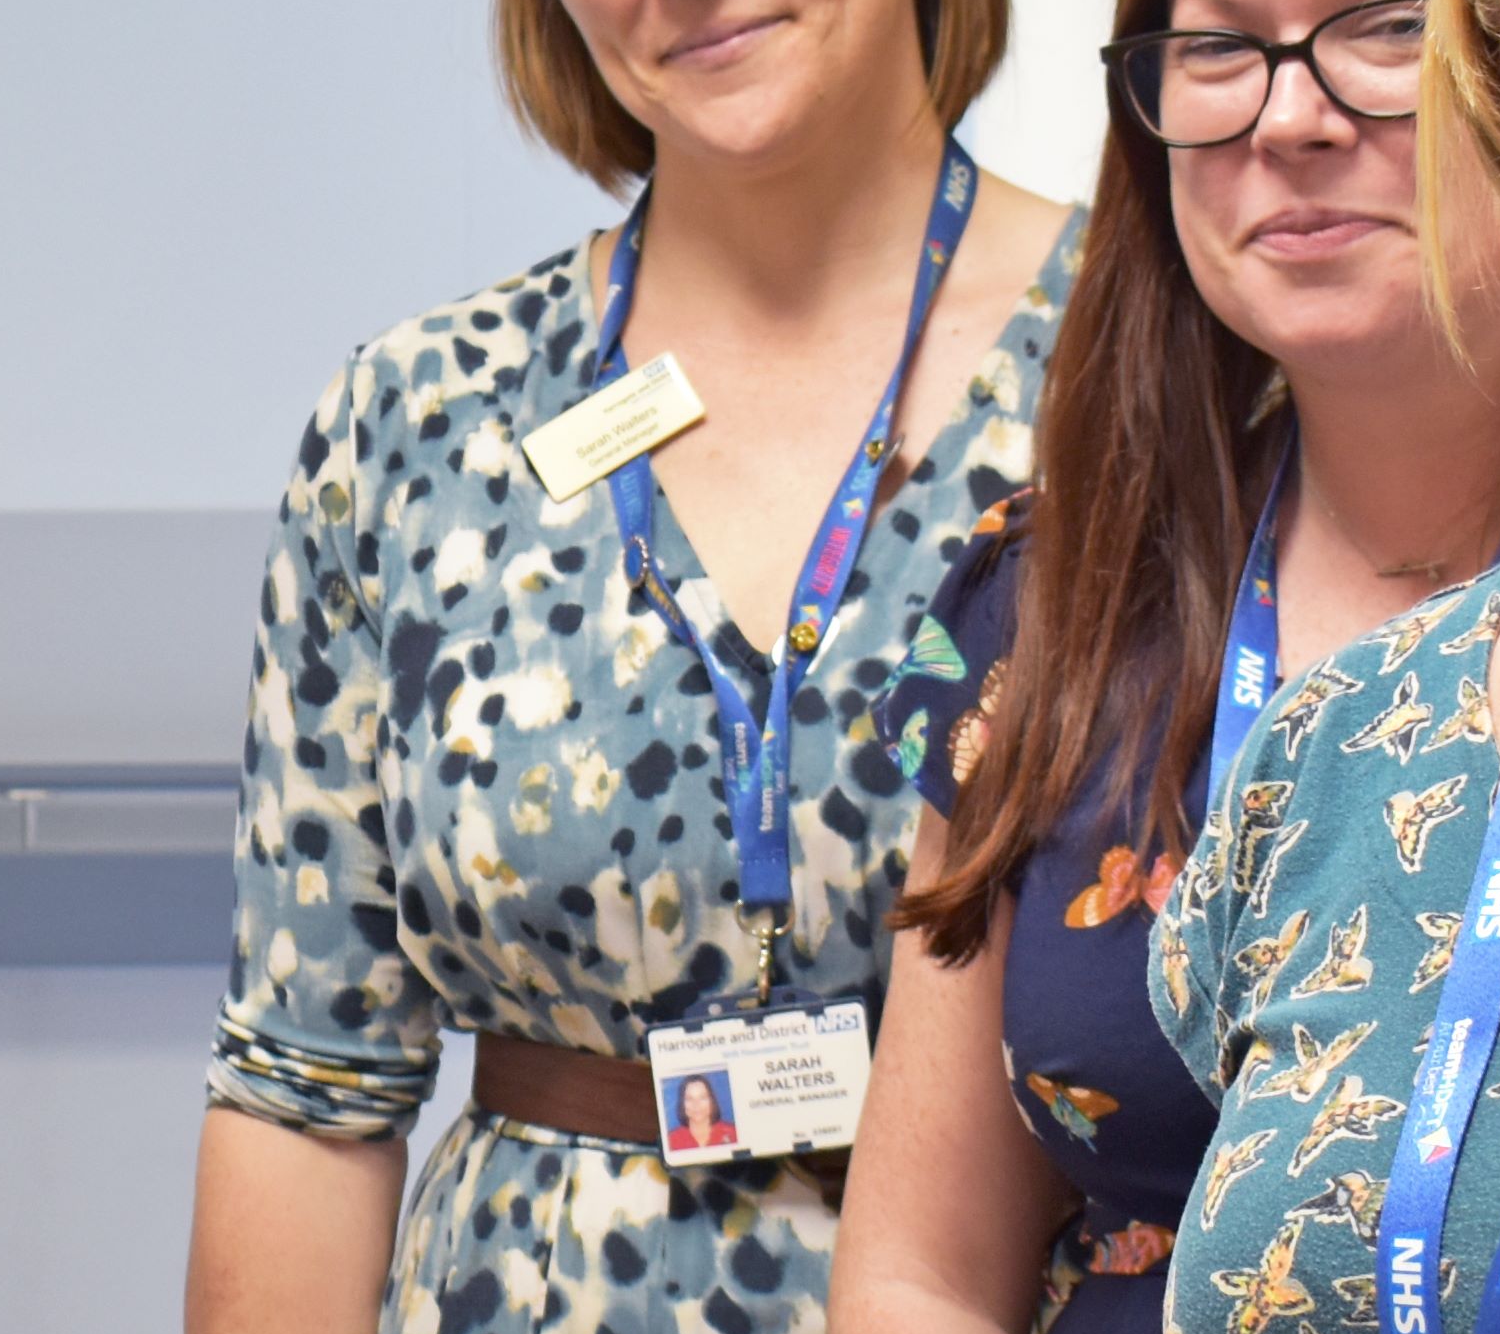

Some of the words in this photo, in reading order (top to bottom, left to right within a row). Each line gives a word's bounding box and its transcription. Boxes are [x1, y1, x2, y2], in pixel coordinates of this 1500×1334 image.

[576, 432, 612, 459] Sarah
[614, 406, 658, 436] Walters
[1234, 647, 1266, 709] NHS
[657, 1033, 726, 1053] Harrogate
[730, 1028, 755, 1043] and
[759, 1022, 808, 1041] District
[817, 1014, 859, 1033] NHS
[757, 1071, 835, 1092] WALTERS
[765, 1056, 822, 1074] SARAH
[1426, 1017, 1473, 1127] teamHDFT
[749, 1095, 796, 1109] GENERAL
[799, 1090, 848, 1102] MANAGER
[1392, 1237, 1426, 1334] NHS
